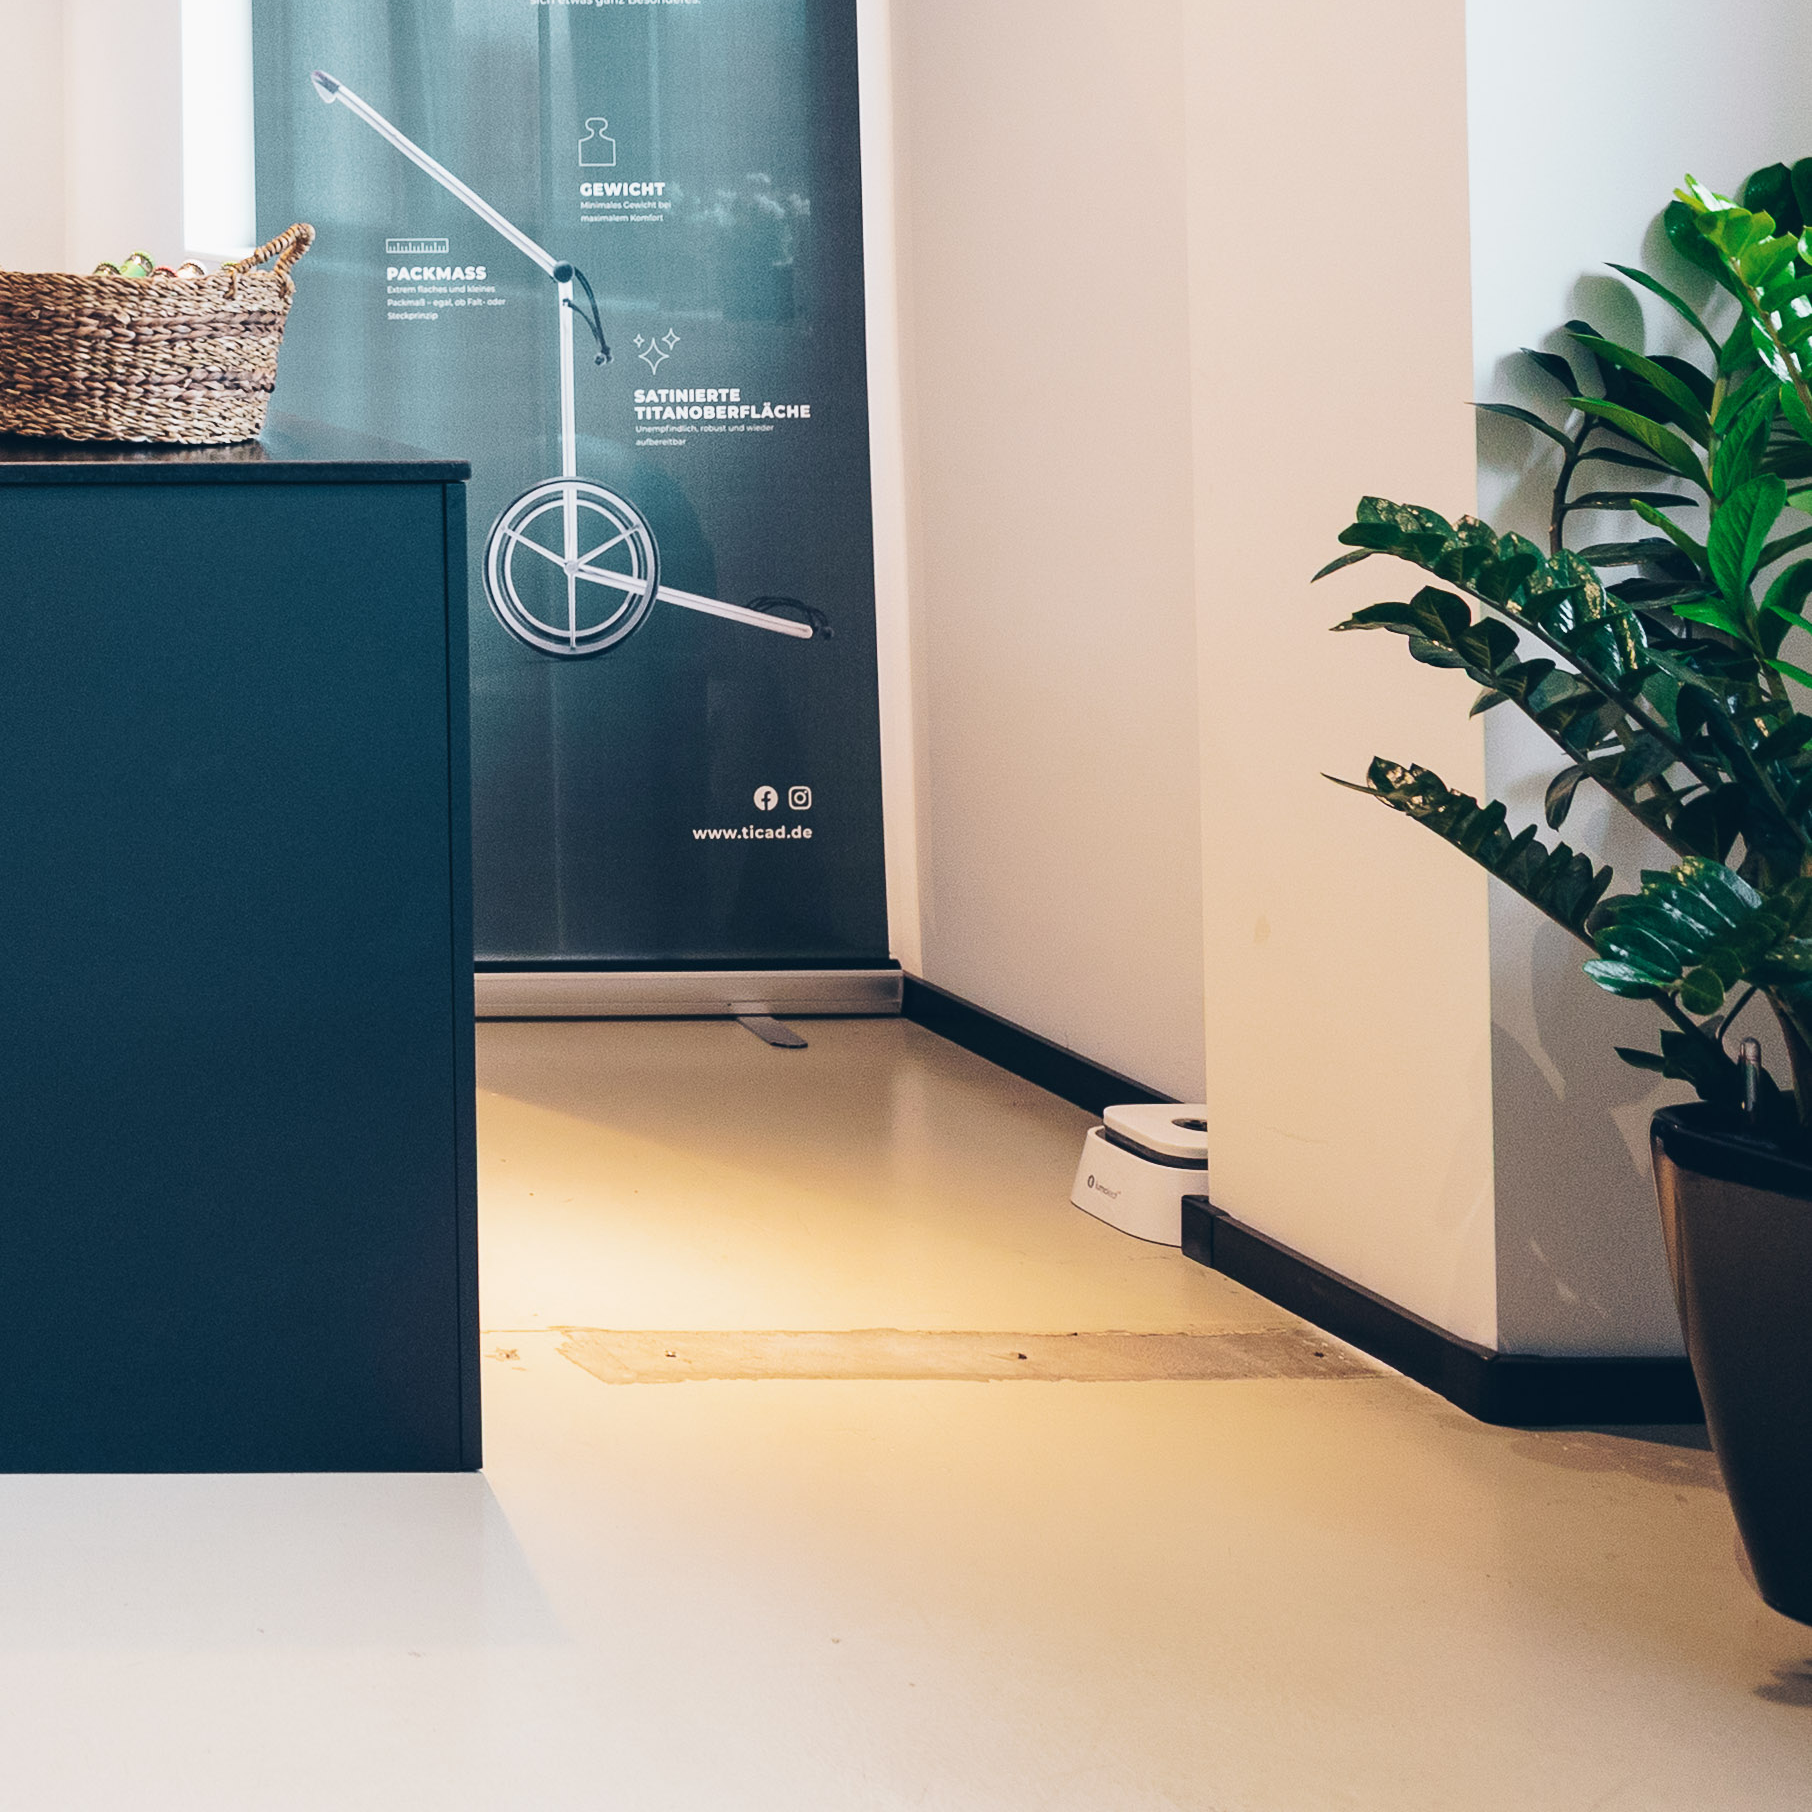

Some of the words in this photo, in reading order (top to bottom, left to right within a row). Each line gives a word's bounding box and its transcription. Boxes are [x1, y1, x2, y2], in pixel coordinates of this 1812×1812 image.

[579, 182, 666, 197] GEWICHT
[386, 266, 487, 281] PACKMASS
[633, 388, 741, 403] SATINIERTE
[634, 402, 811, 420] TITANOBERFLÄCHE
[728, 424, 745, 432] und
[692, 825, 813, 840] www.ticad.de
